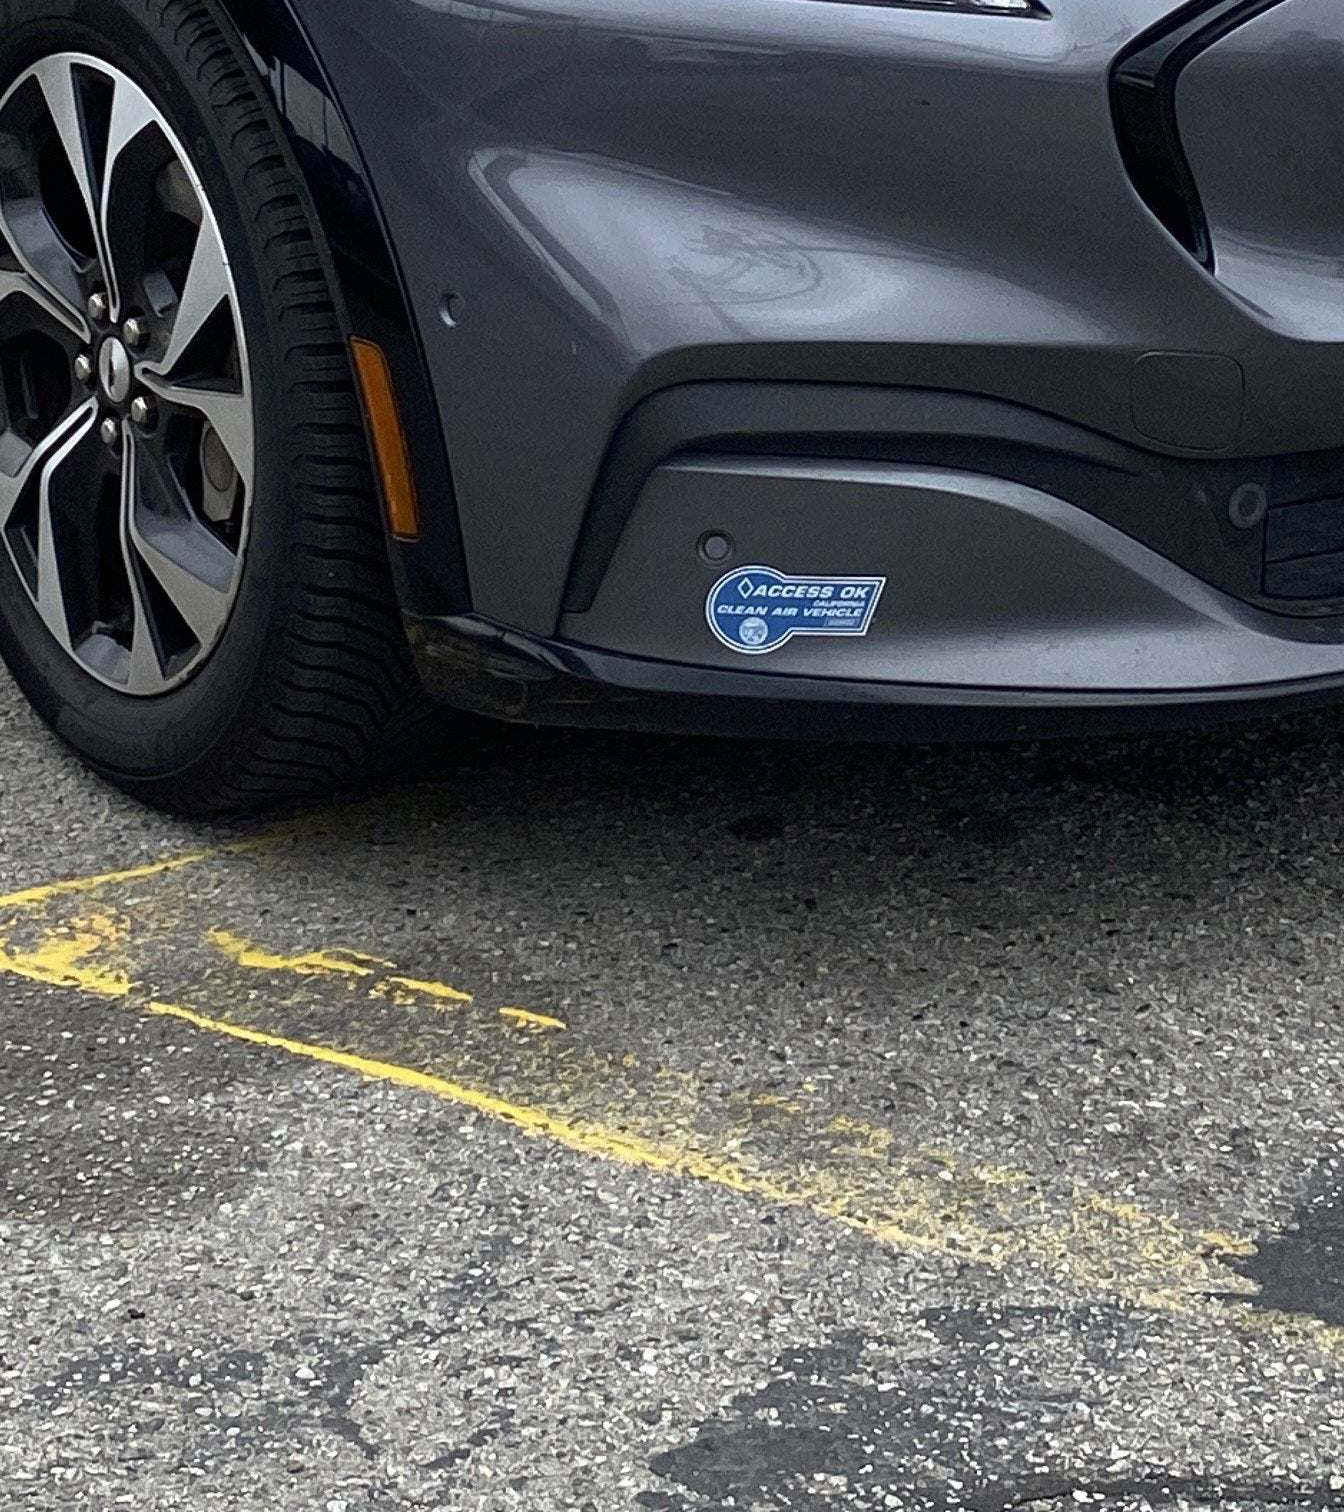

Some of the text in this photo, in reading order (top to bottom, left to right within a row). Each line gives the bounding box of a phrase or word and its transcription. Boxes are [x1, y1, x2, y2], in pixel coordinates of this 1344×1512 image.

[752, 584, 870, 599] ACCESS OK
[717, 604, 864, 617] CLEAN AIR VEHICLE
